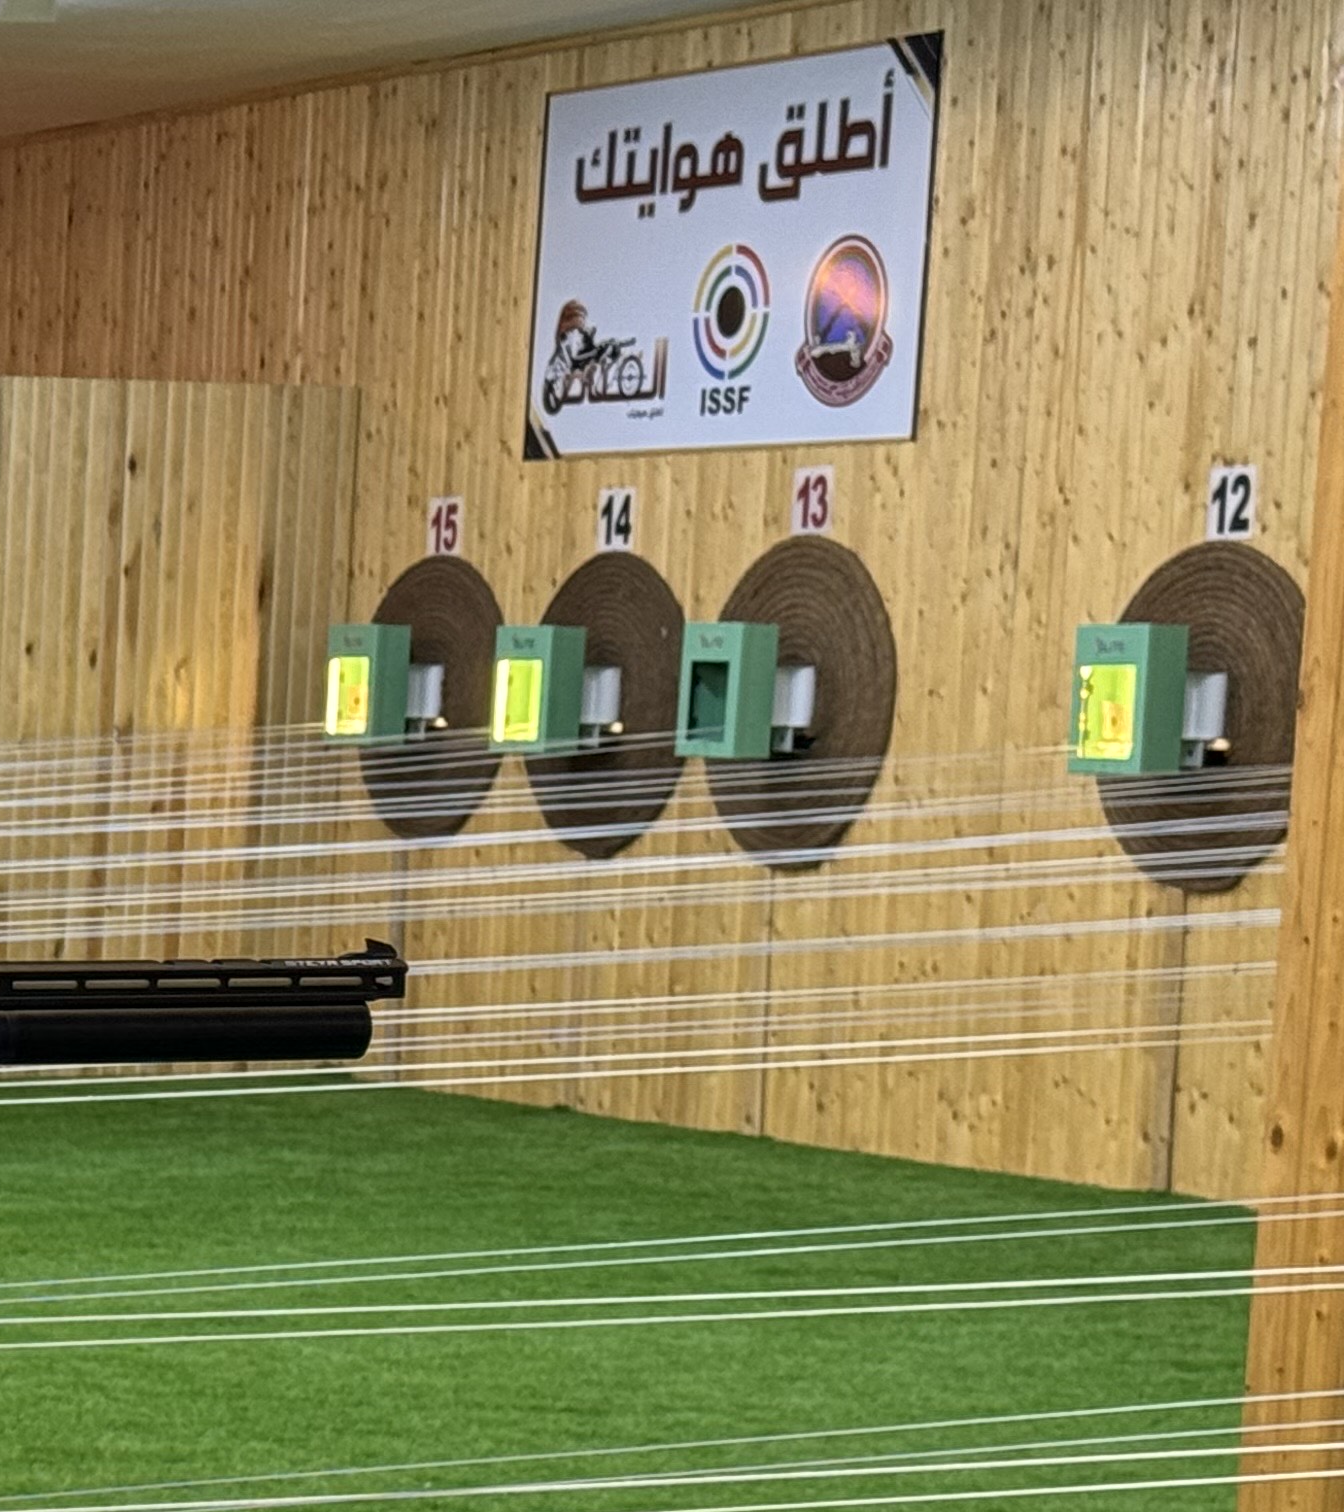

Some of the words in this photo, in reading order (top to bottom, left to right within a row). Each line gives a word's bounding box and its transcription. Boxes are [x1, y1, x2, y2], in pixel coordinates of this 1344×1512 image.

[759, 69, 894, 203] أطلق
[575, 122, 745, 218] هوايتك
[699, 386, 751, 416] ISSF
[430, 503, 458, 553] 15
[601, 494, 631, 546] 14
[797, 474, 828, 529] 13
[1211, 473, 1252, 535] 12
